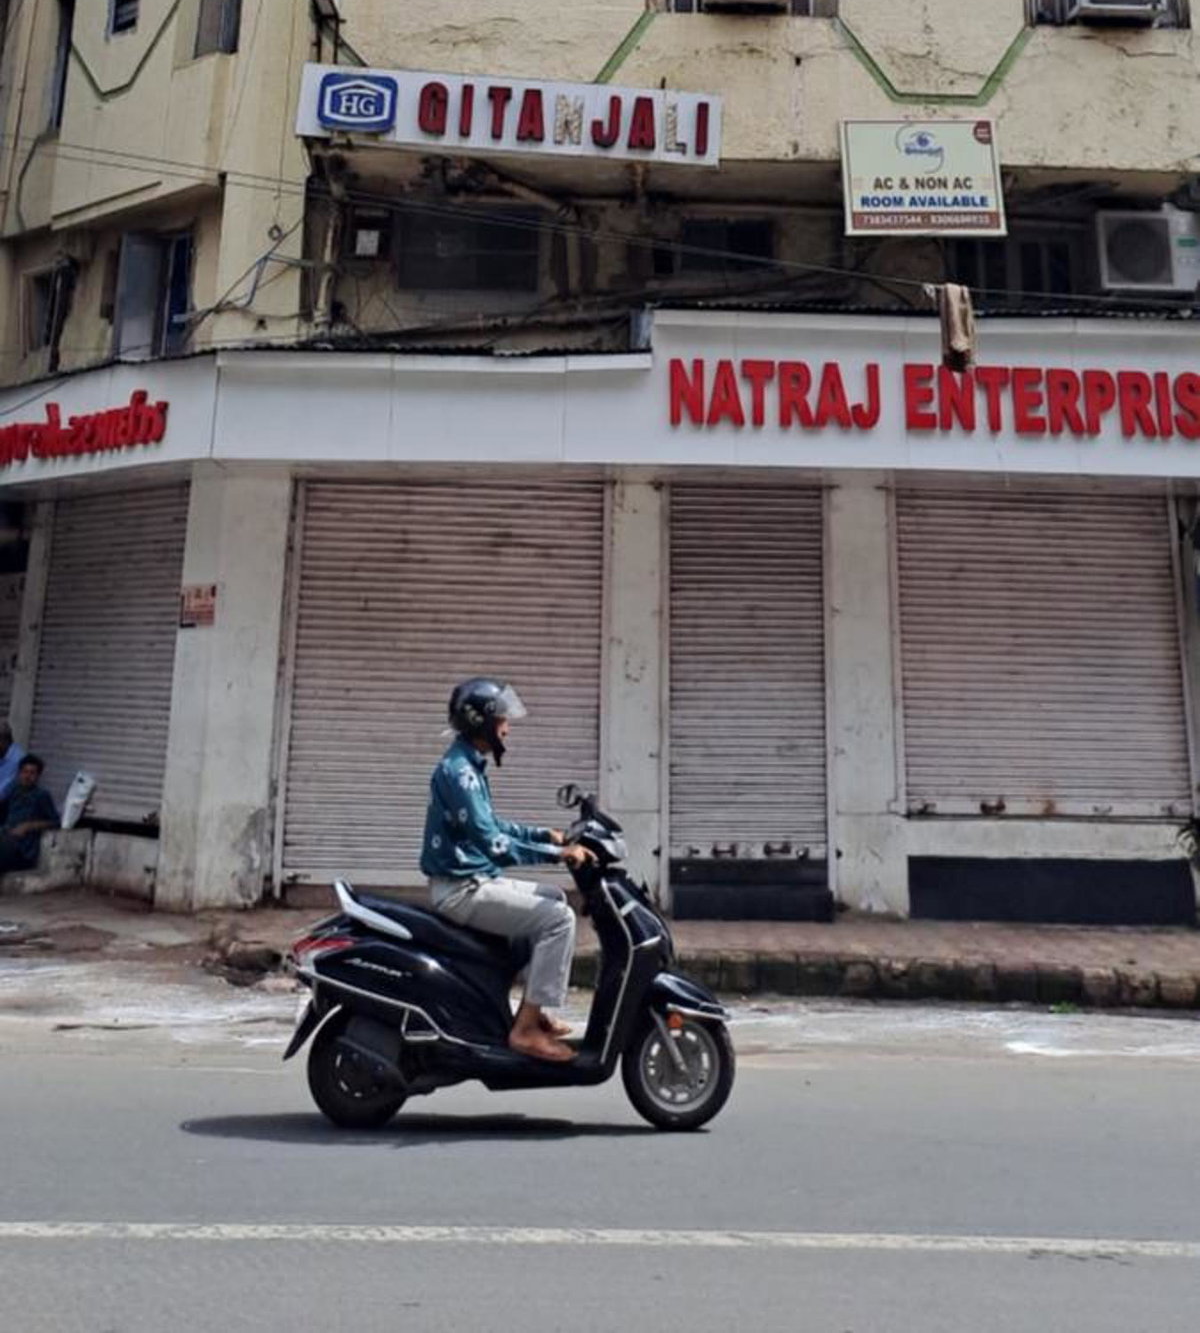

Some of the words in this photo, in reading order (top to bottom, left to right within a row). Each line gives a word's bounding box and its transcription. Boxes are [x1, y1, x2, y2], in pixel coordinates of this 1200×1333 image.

[340, 95, 375, 116] HG
[418, 81, 710, 157] GITANJALI
[860, 196, 904, 207] ROOM
[908, 196, 989, 207] AVAILABLE
[873, 177, 894, 190] AC
[899, 177, 909, 190] &
[915, 177, 948, 190] NON
[952, 177, 973, 190] AC
[669, 358, 880, 431] NATRAJ
[903, 363, 1200, 439] ENTERPRIS
